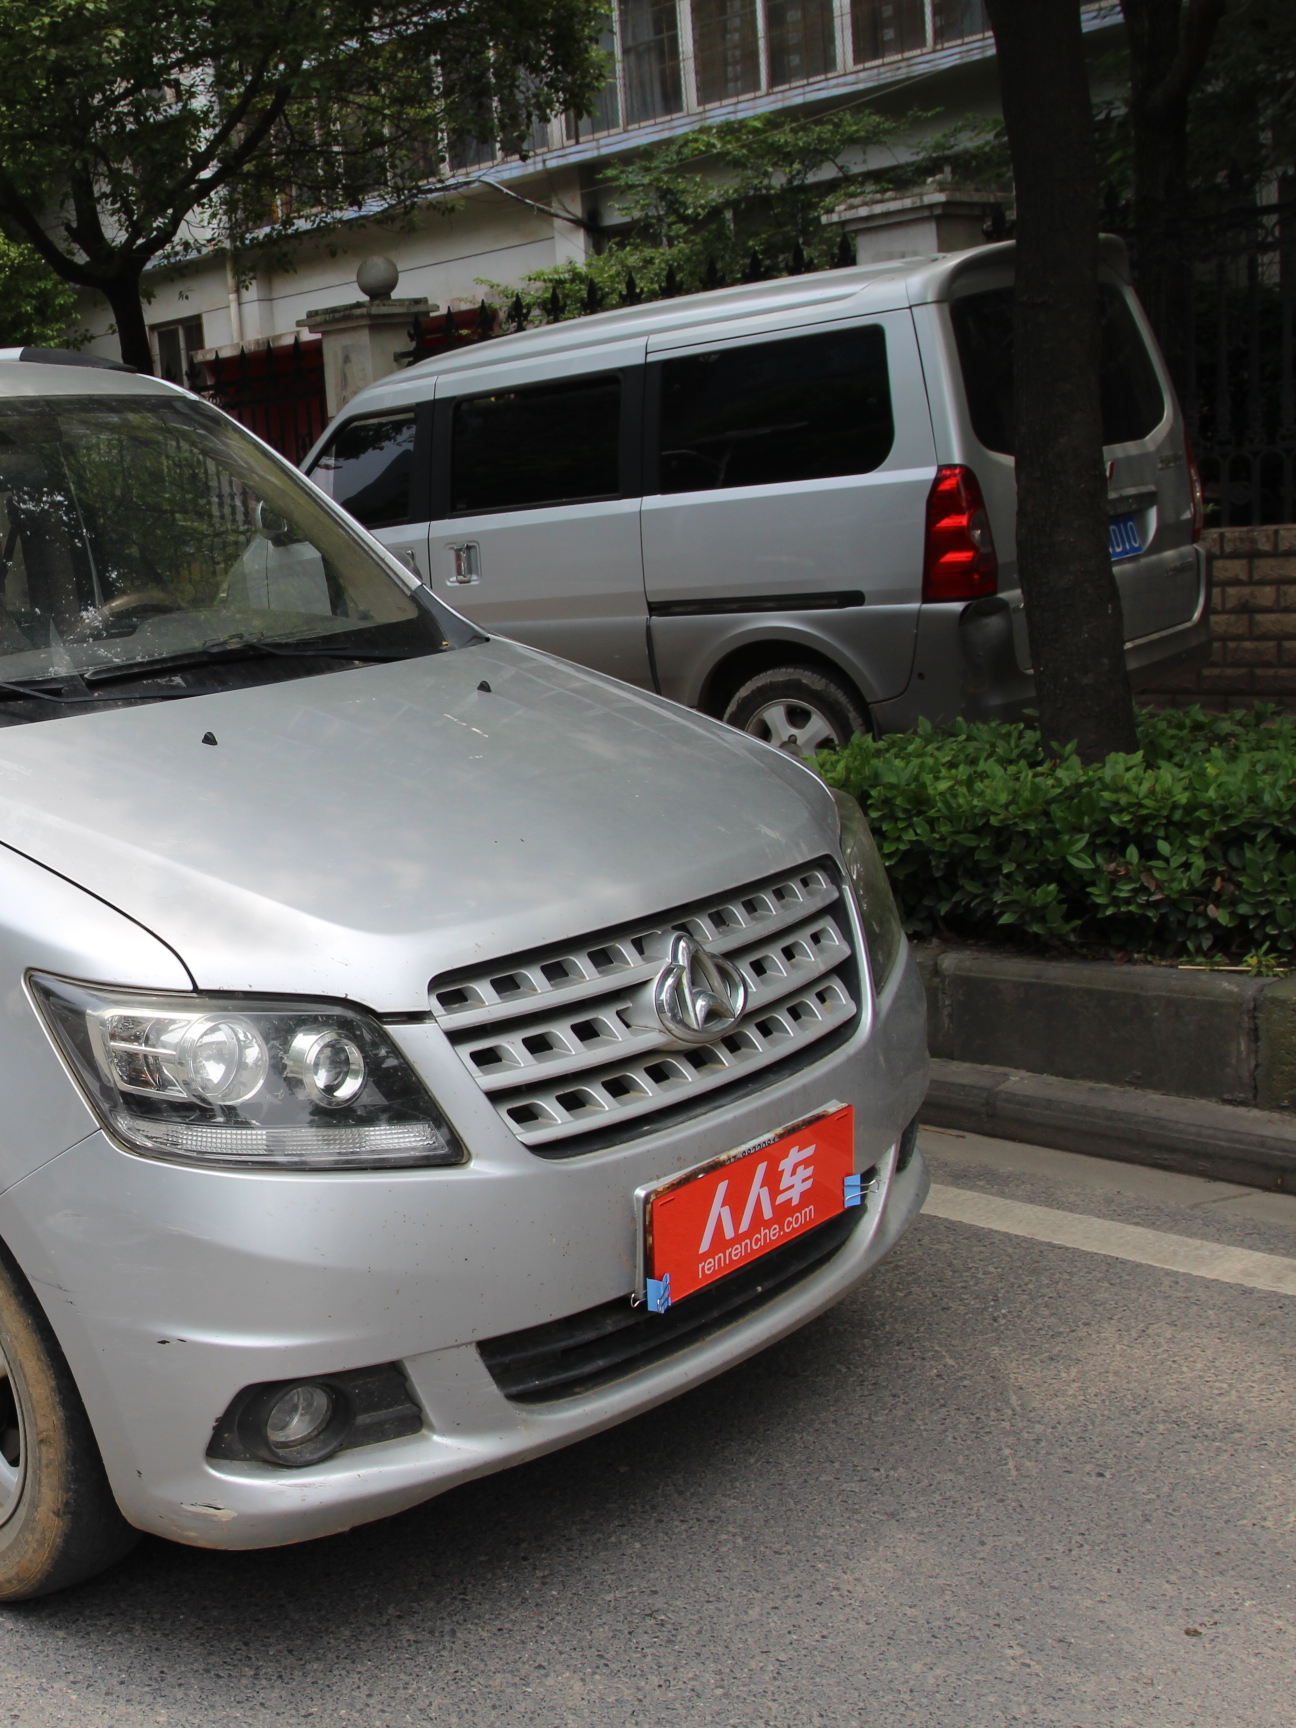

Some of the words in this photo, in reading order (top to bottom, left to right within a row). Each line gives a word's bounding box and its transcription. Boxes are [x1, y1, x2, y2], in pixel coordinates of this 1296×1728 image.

[698, 1205, 815, 1278] renrenche.com
[699, 1144, 816, 1254] 人人车
